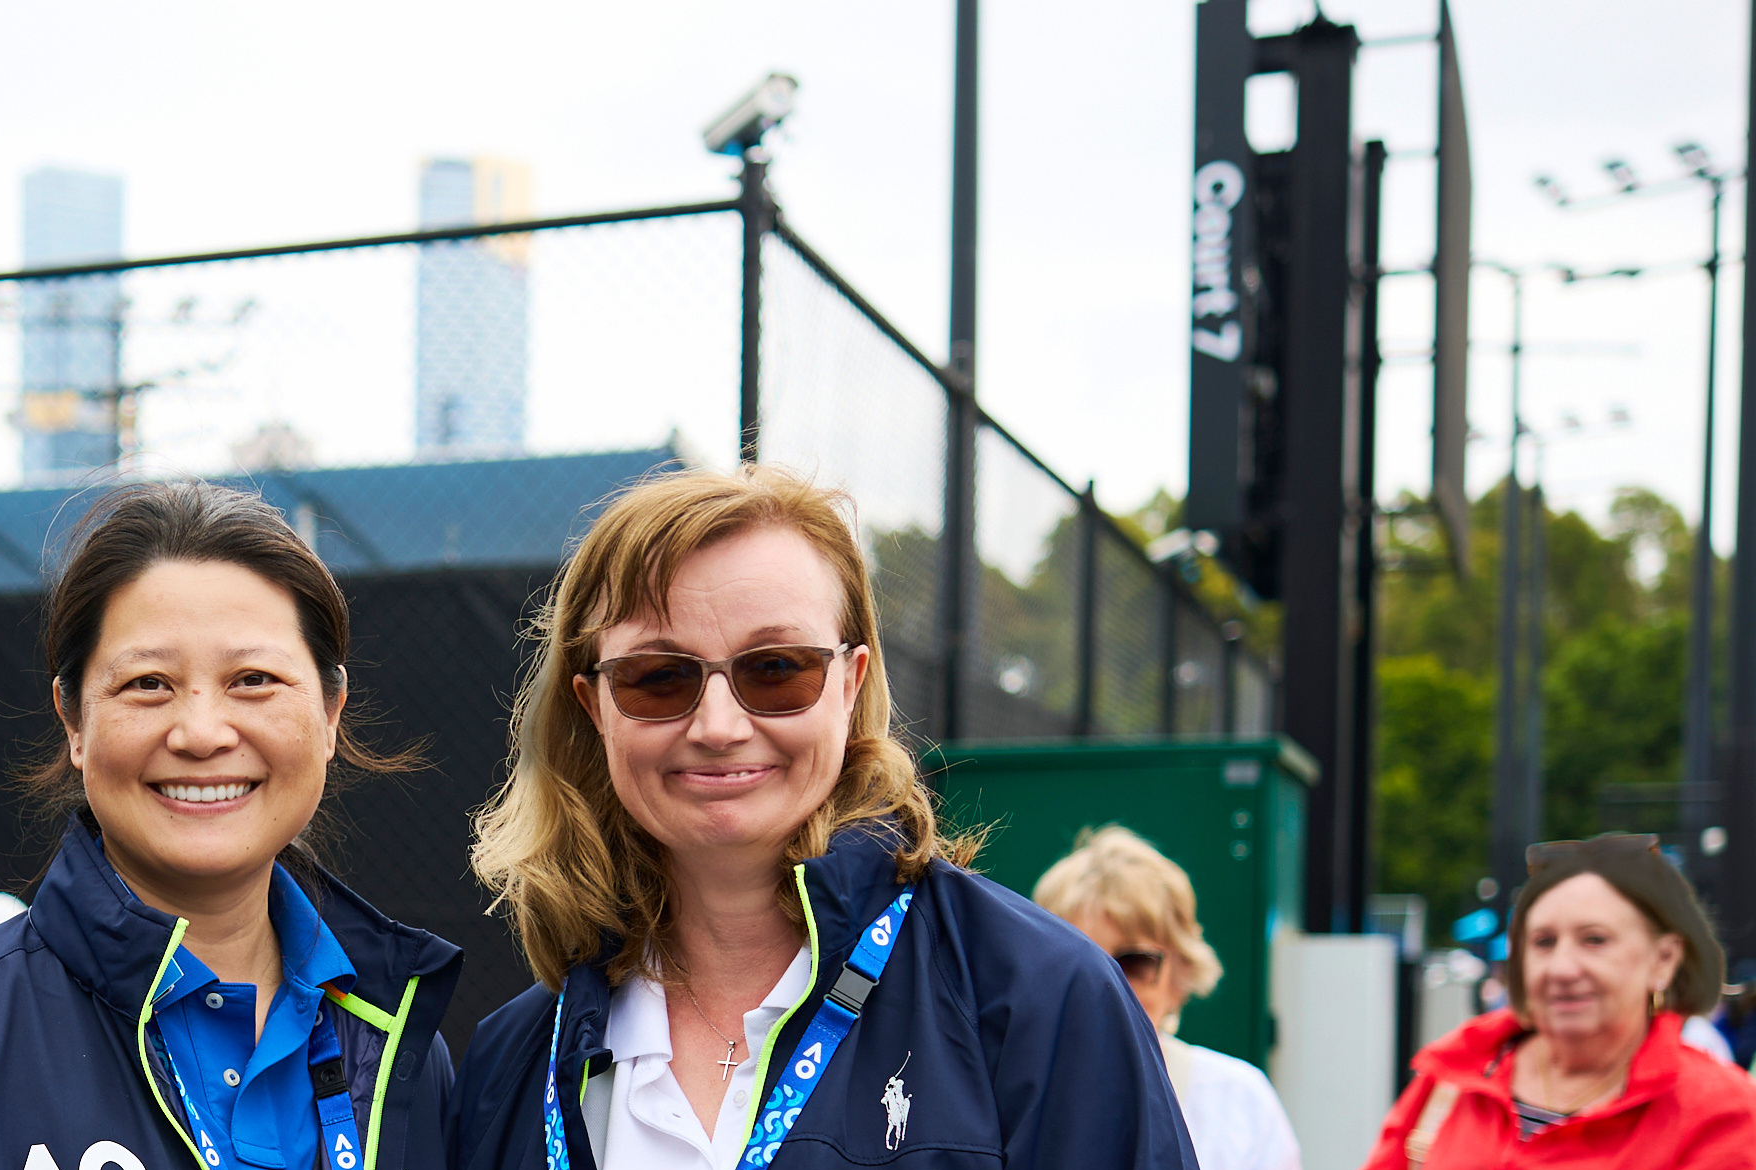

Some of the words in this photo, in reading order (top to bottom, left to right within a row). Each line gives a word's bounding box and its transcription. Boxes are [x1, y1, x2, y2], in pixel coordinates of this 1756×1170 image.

[1193, 159, 1245, 319] Court
[1192, 320, 1242, 363] 7
[870, 914, 892, 946] AO
[793, 1041, 822, 1080] AO
[200, 1130, 220, 1167] AO
[334, 1133, 357, 1170] AO
